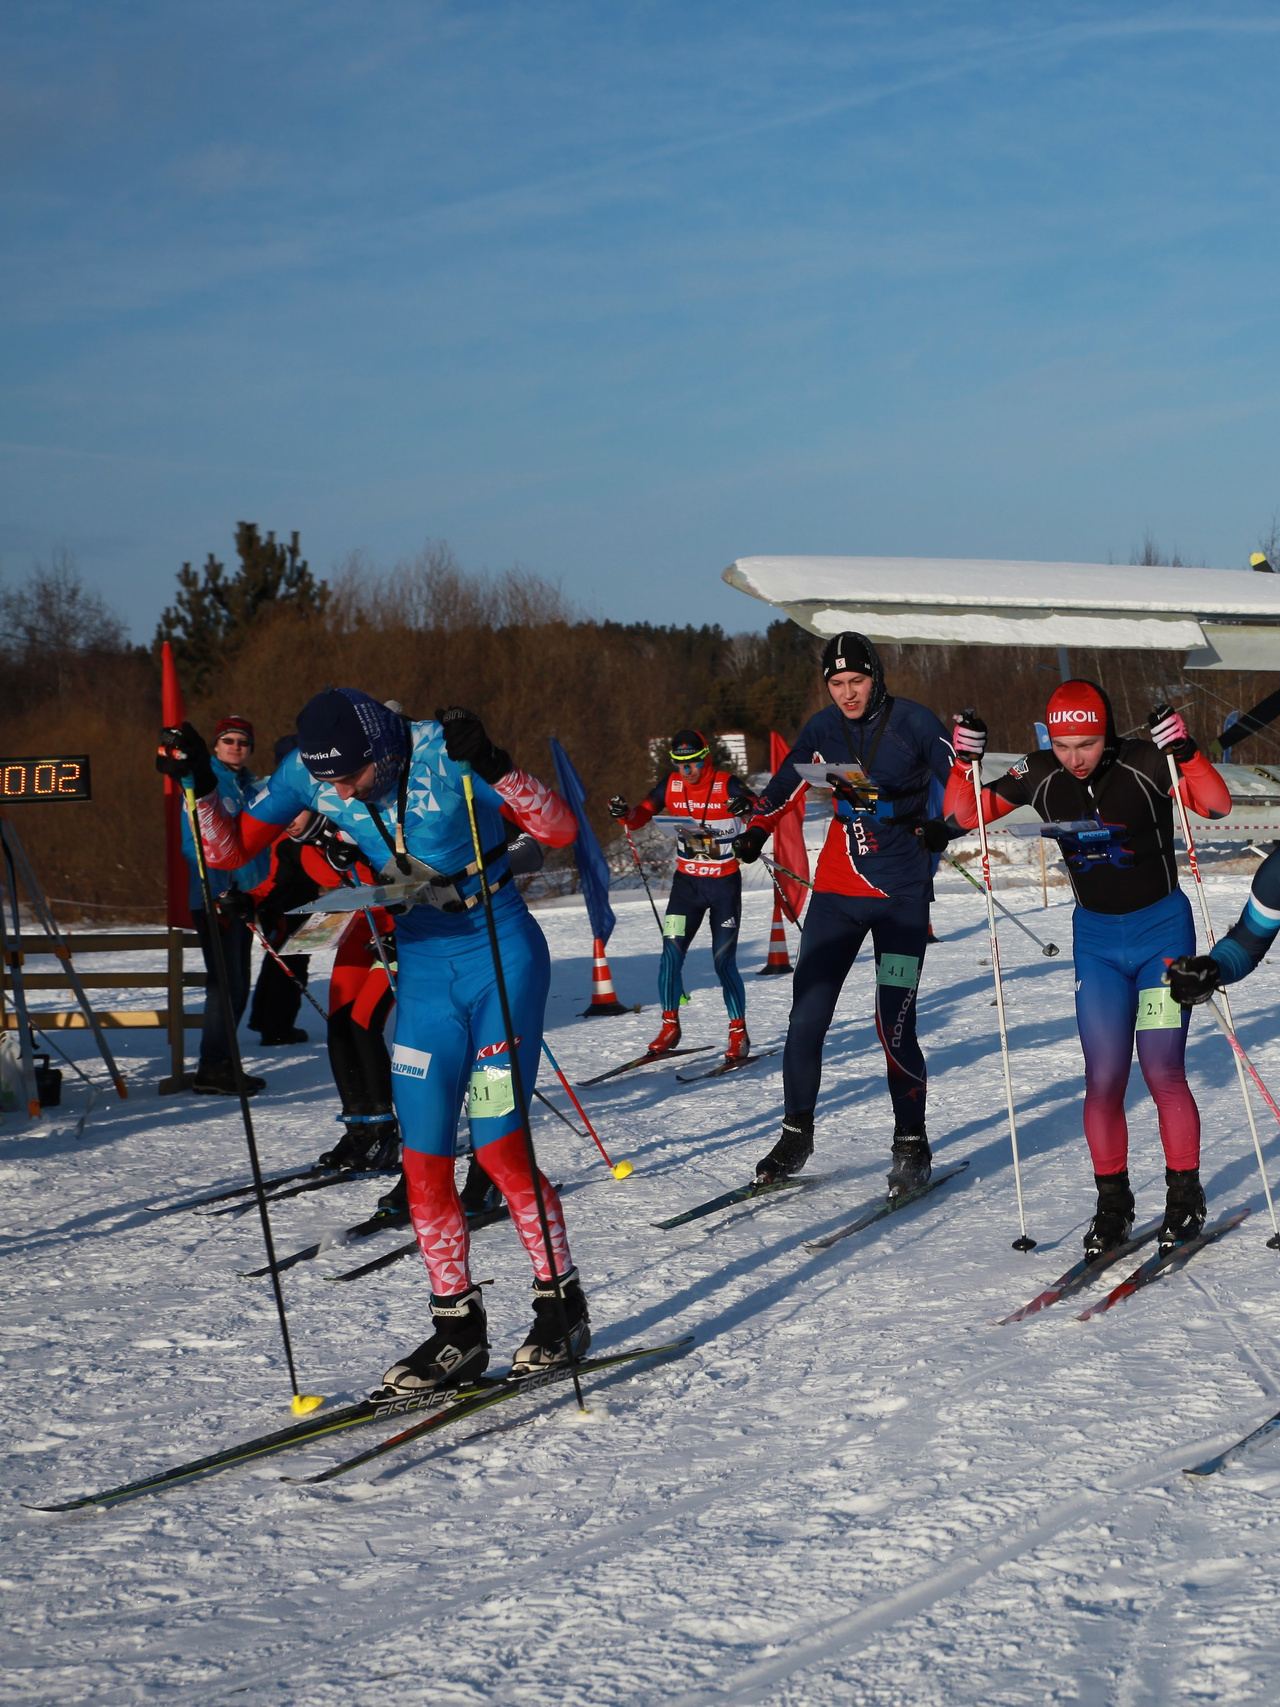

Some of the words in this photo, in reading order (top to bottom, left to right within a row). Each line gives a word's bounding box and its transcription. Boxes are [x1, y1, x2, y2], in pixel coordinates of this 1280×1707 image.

[1048, 710, 1098, 724] LUKOIL
[888, 965, 905, 978] 4.1
[1146, 1001, 1164, 1016] 2.1
[392, 1061, 425, 1076] GAZPROM
[471, 1085, 491, 1102] 3.1
[373, 1388, 459, 1419] FISCHER
